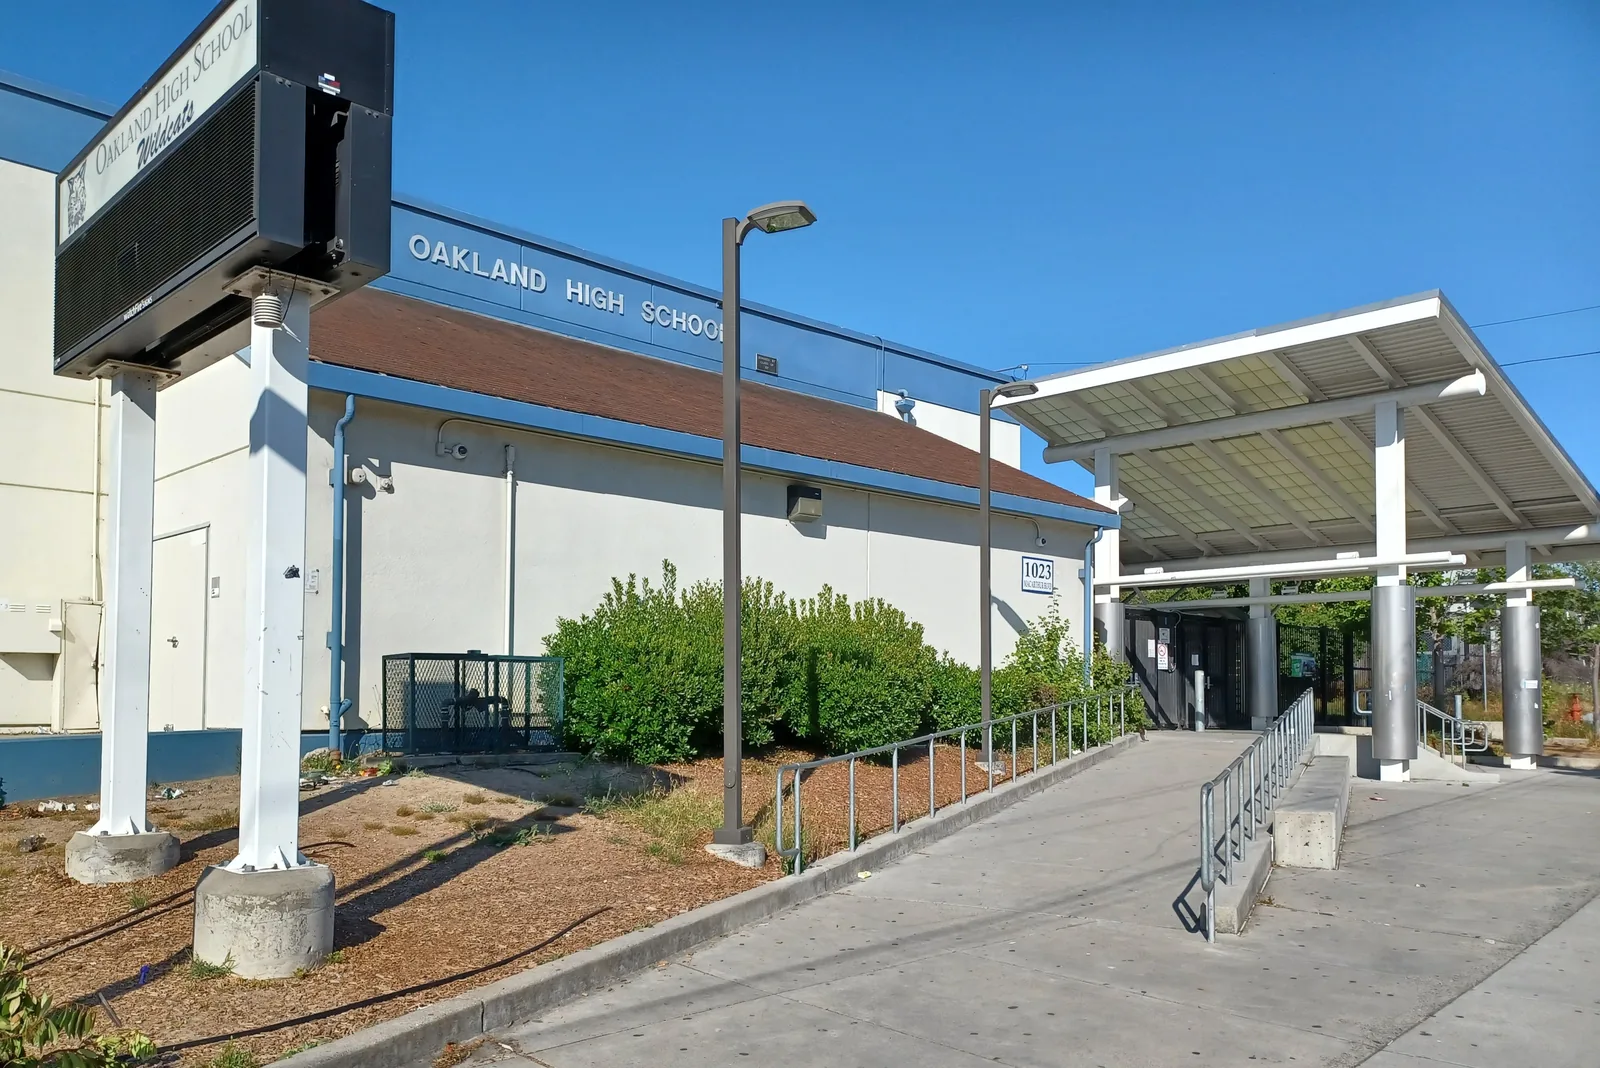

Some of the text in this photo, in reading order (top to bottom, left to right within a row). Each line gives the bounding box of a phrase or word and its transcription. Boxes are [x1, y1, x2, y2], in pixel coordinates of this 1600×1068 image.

[96, 4, 252, 175] OAKLAND HIGH SCHOOL
[136, 99, 194, 169] Wildcats
[408, 234, 546, 293] OAKLAND
[566, 279, 624, 315] HIGH
[1025, 561, 1052, 580] 1023
